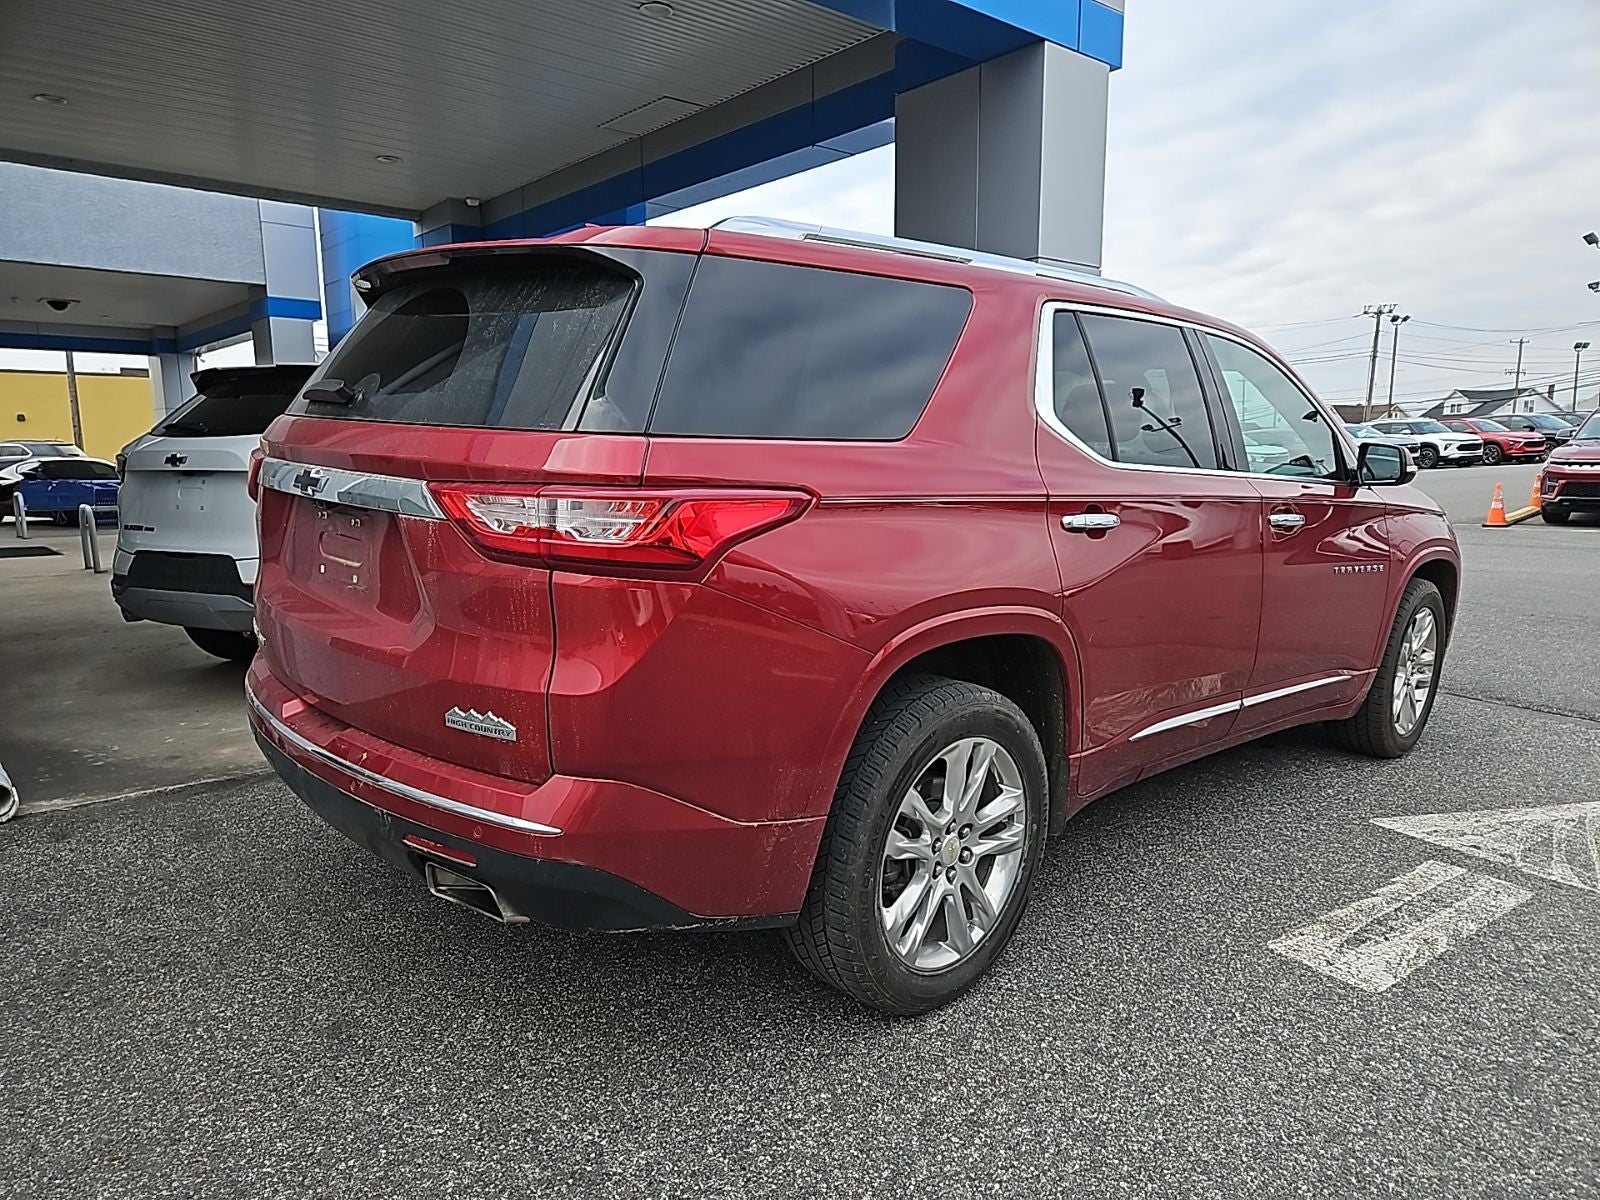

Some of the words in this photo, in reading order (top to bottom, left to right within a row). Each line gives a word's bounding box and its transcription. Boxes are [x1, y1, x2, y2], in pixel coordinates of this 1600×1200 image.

[1333, 564, 1384, 574] TRAVERSE
[447, 718, 467, 728] HIGH
[469, 723, 512, 737] COUNTRY
